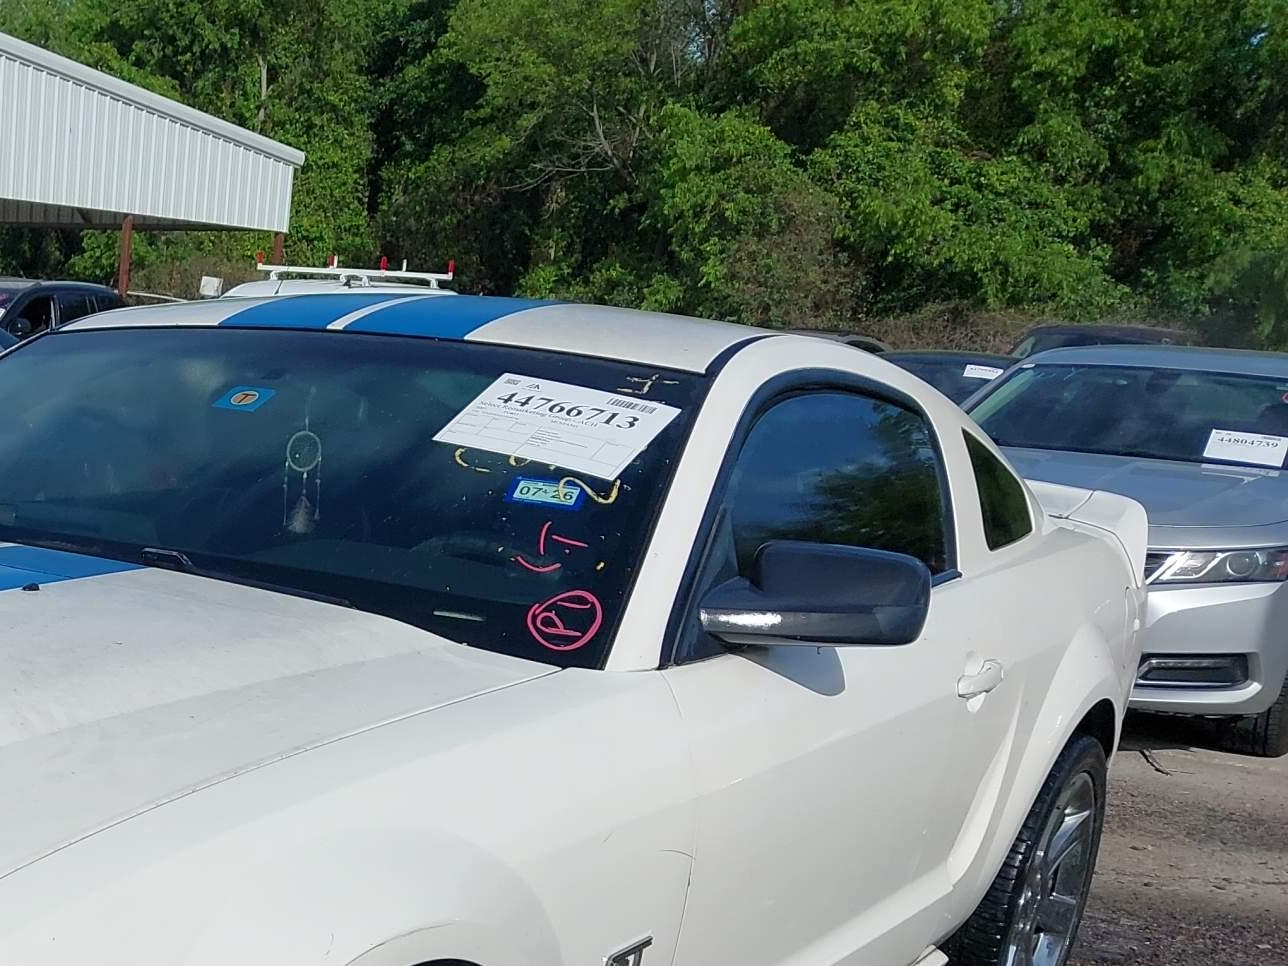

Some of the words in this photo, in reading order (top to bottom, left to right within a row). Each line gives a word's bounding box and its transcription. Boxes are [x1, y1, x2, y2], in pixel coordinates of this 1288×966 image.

[496, 391, 640, 431] 44766713
[1217, 437, 1279, 448] 44804739
[519, 486, 544, 496] 07
